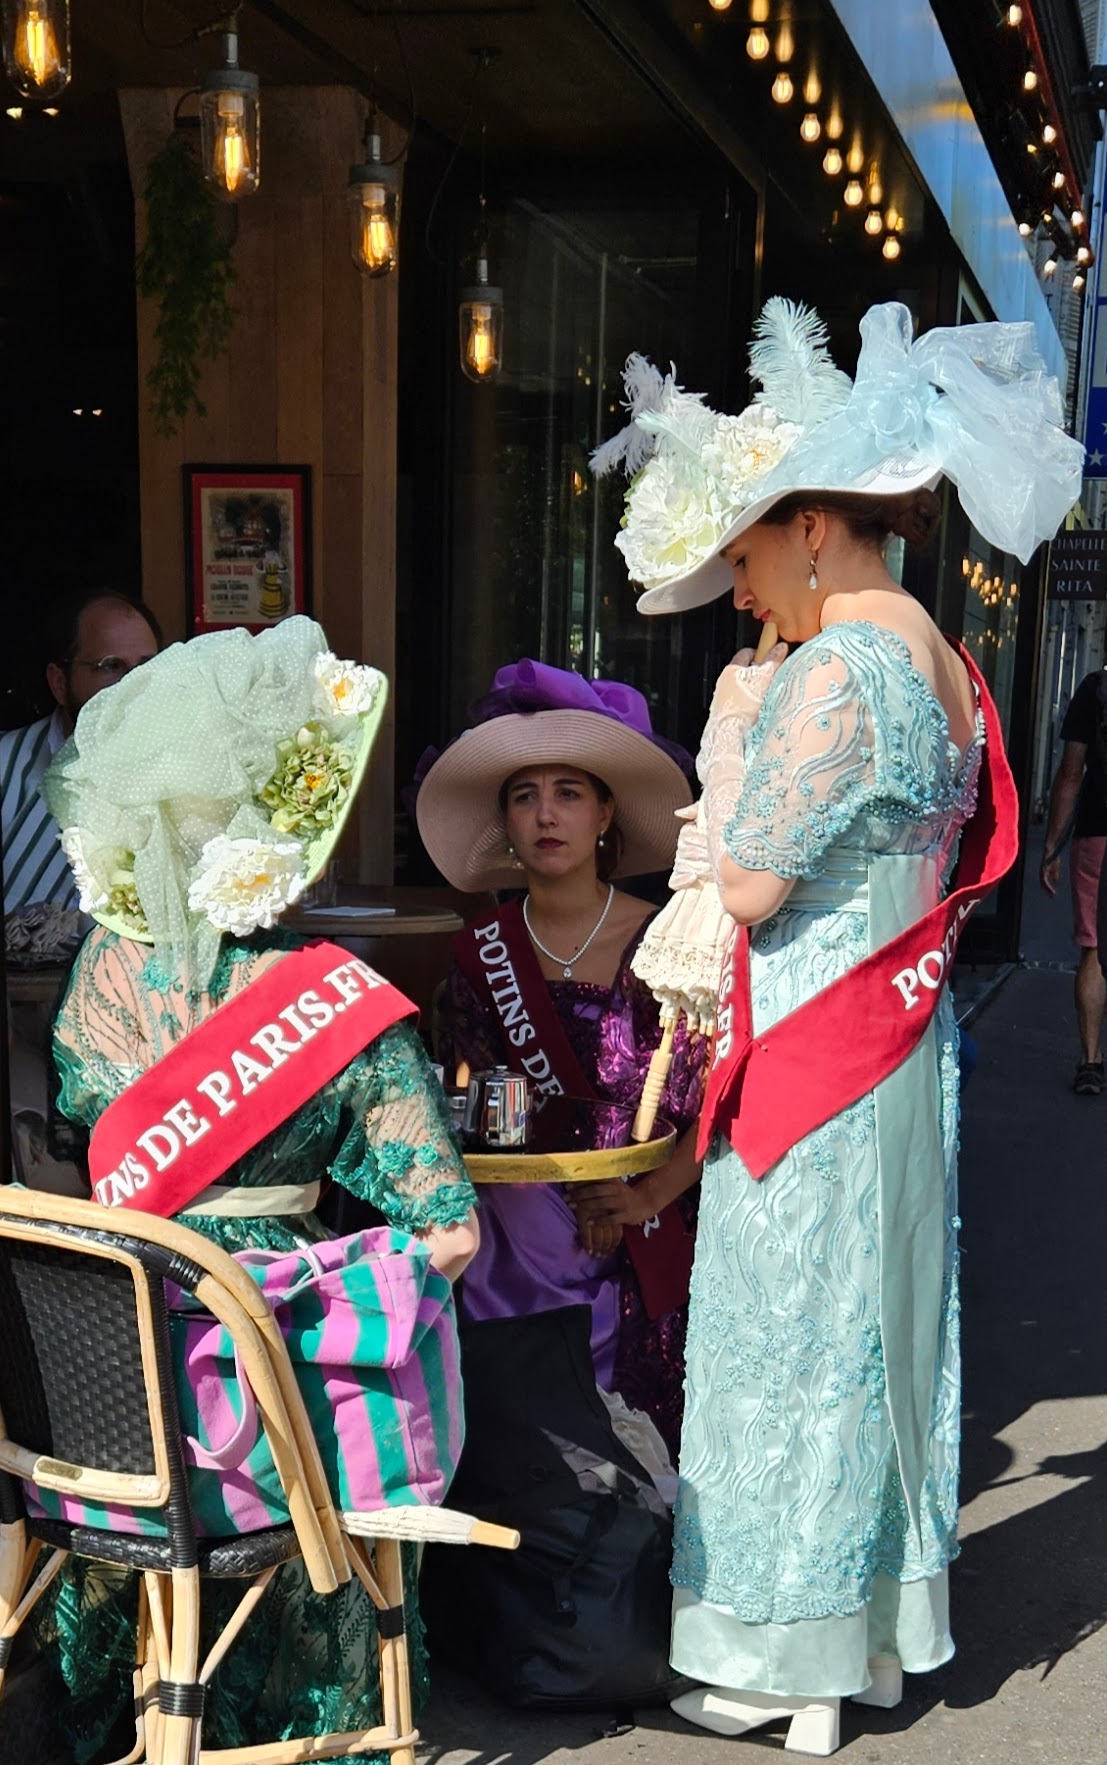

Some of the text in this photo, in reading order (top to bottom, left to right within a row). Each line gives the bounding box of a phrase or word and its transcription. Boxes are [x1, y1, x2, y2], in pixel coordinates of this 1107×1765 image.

[1051, 559, 1101, 572] SAINTE
[1057, 580, 1093, 592] RITA
[474, 920, 565, 1096] POTINS DE
[136, 1098, 211, 1172] DE
[197, 959, 390, 1117] PARIS.FR
